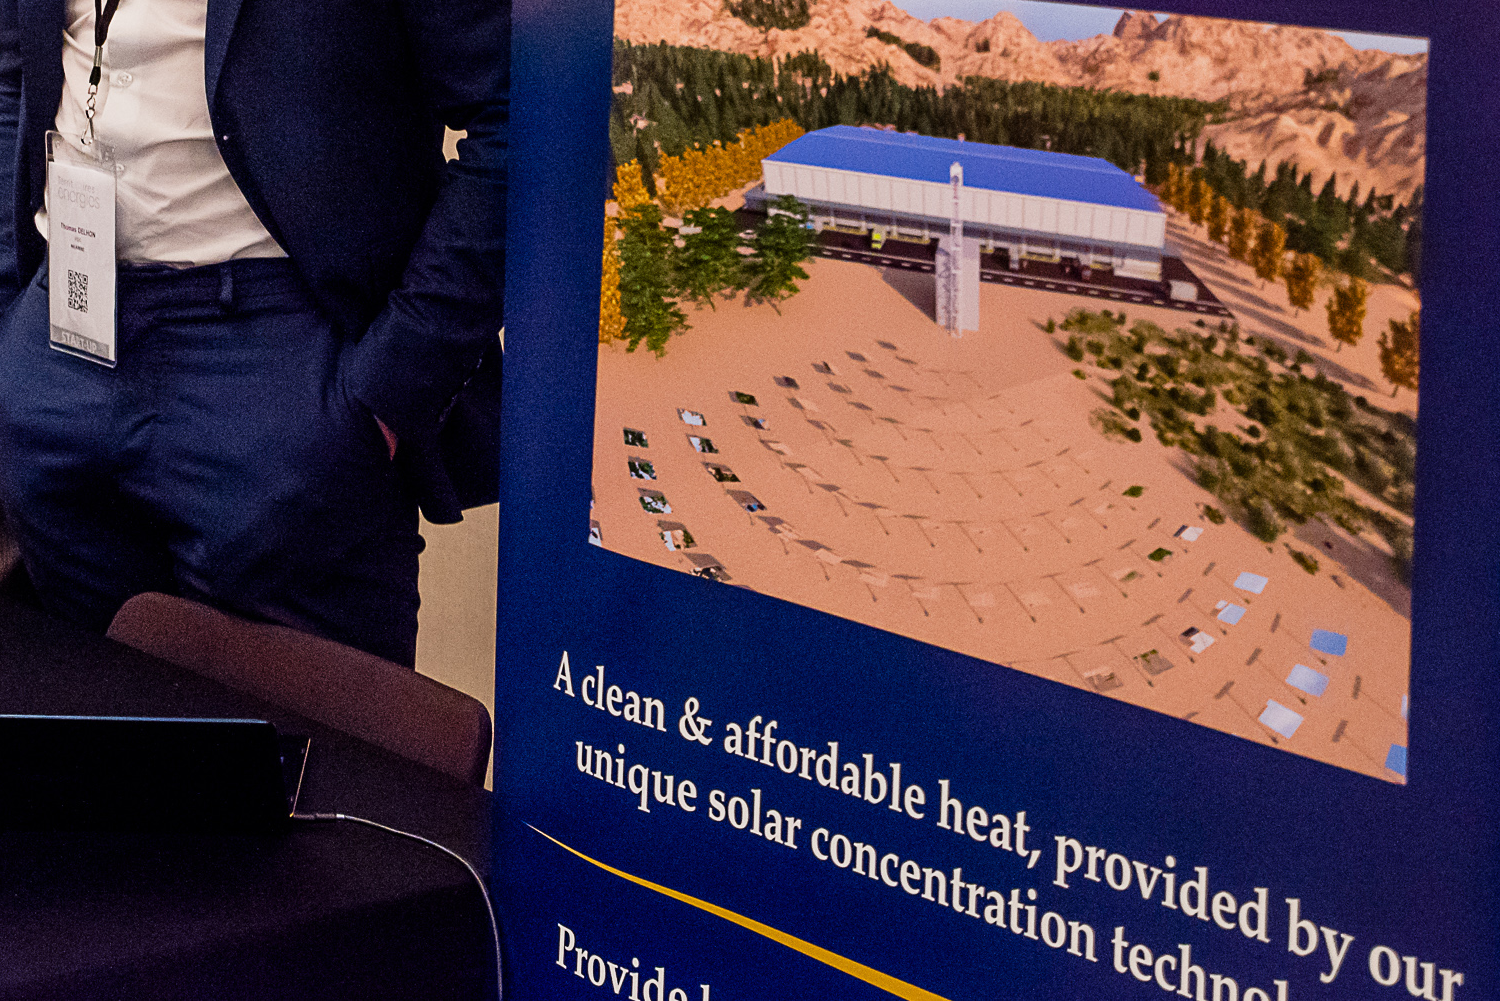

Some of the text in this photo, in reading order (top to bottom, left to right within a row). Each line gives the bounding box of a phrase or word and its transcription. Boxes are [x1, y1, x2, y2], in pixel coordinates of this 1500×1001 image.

[553, 650, 1464, 1001] A clean & affordable heat, provided by our
[575, 741, 698, 814] unique
[708, 789, 802, 850] solar
[811, 827, 1098, 963] concentration
